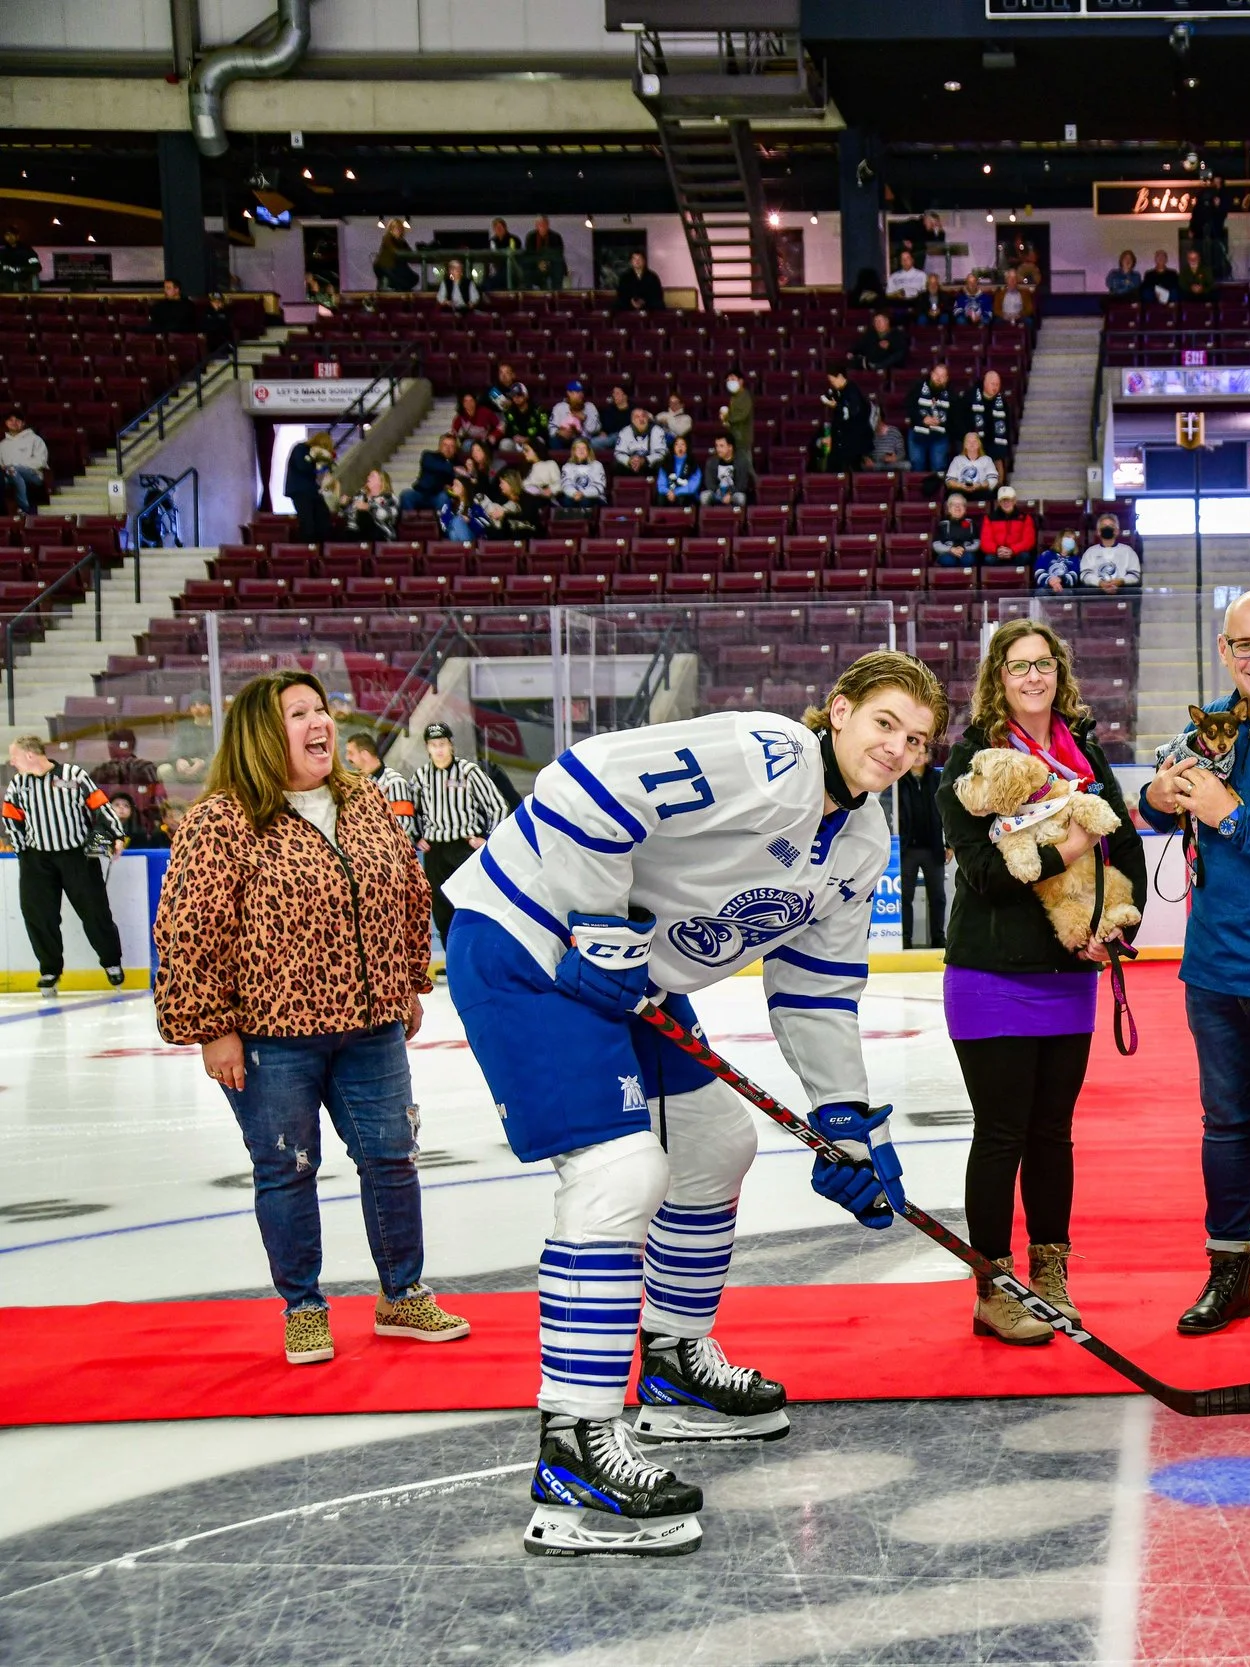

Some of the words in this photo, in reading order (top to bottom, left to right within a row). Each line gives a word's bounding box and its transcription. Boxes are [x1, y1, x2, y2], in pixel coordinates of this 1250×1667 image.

[1185, 351, 1205, 365] EXIT
[318, 362, 339, 377] EXIT
[638, 747, 716, 821] 77
[722, 888, 801, 916] MISSISSAUGA
[876, 898, 902, 915] Sel
[586, 941, 652, 959] CC
[992, 1274, 1093, 1344] CCM
[650, 1383, 673, 1403] TACKS
[541, 1468, 580, 1506] CCM
[661, 1522, 685, 1537] CCM
